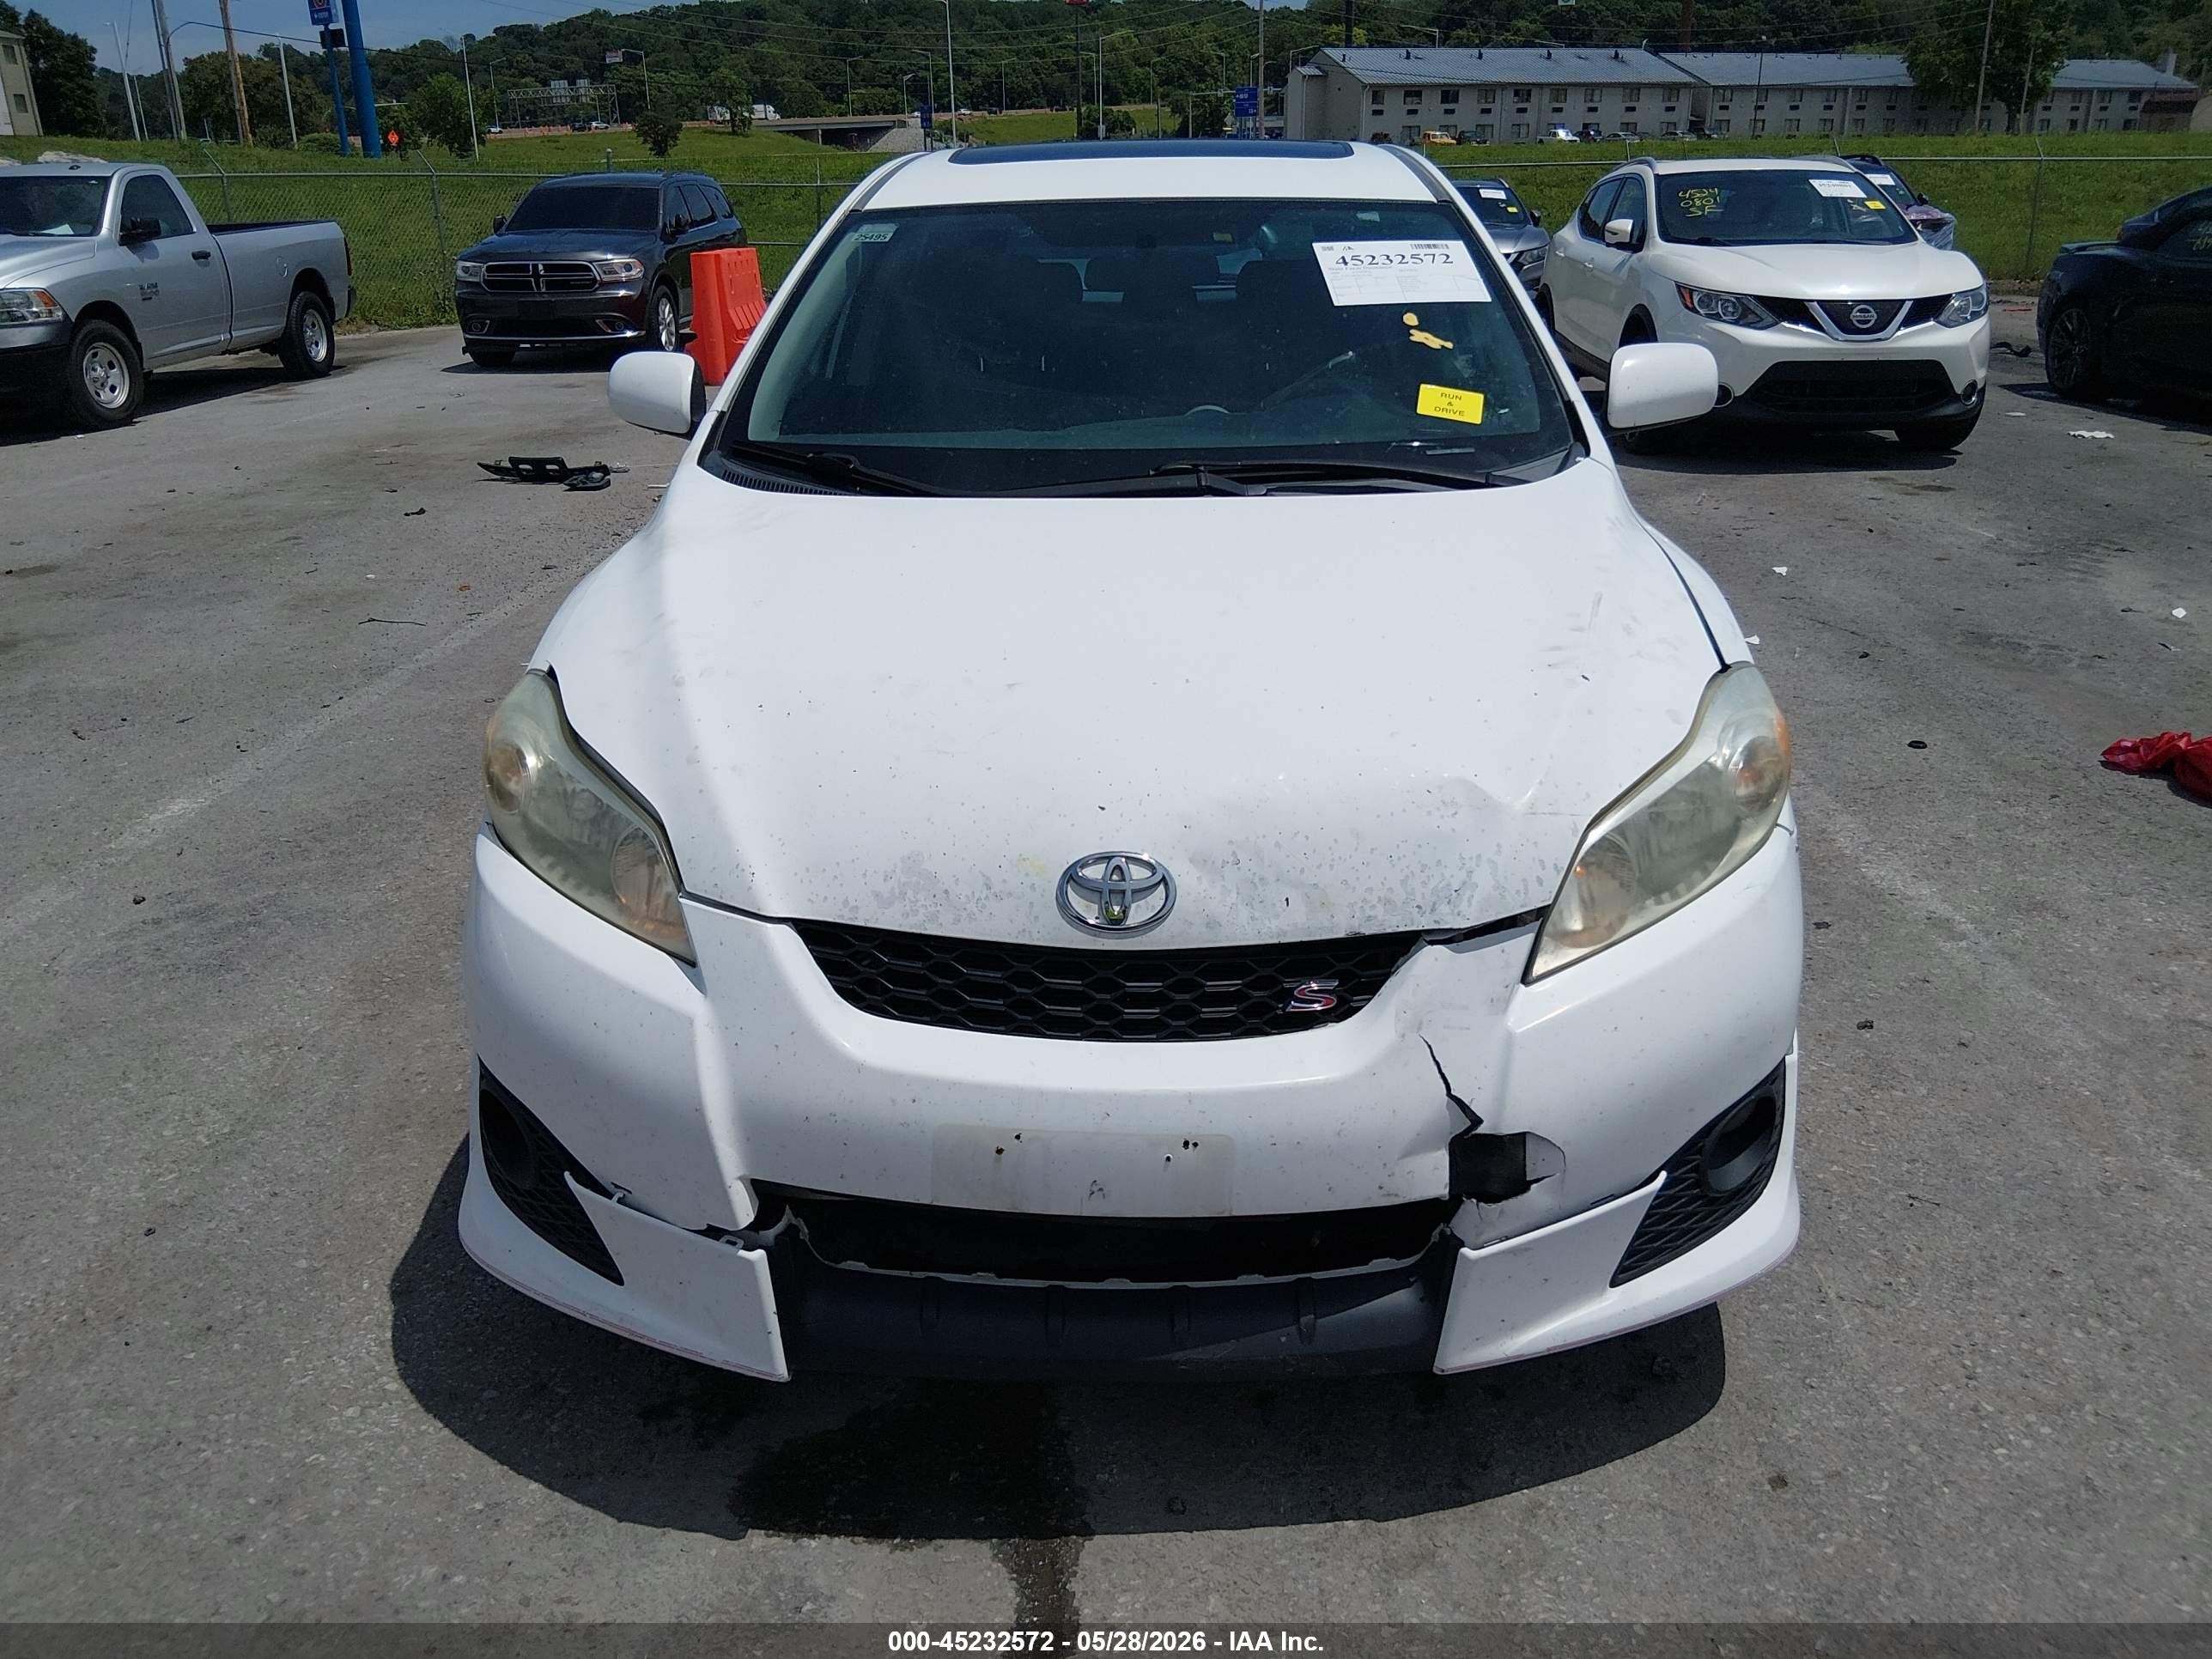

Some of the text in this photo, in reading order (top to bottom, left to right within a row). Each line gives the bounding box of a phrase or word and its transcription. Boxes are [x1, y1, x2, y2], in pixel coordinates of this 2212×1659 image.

[1680, 197, 1720, 207] 0801
[1685, 205, 1724, 216] SF
[1335, 253, 1454, 266] 45232572
[1440, 392, 1462, 401] RUN
[1434, 406, 1465, 416] DRIVE
[1285, 979, 1340, 1012] S
